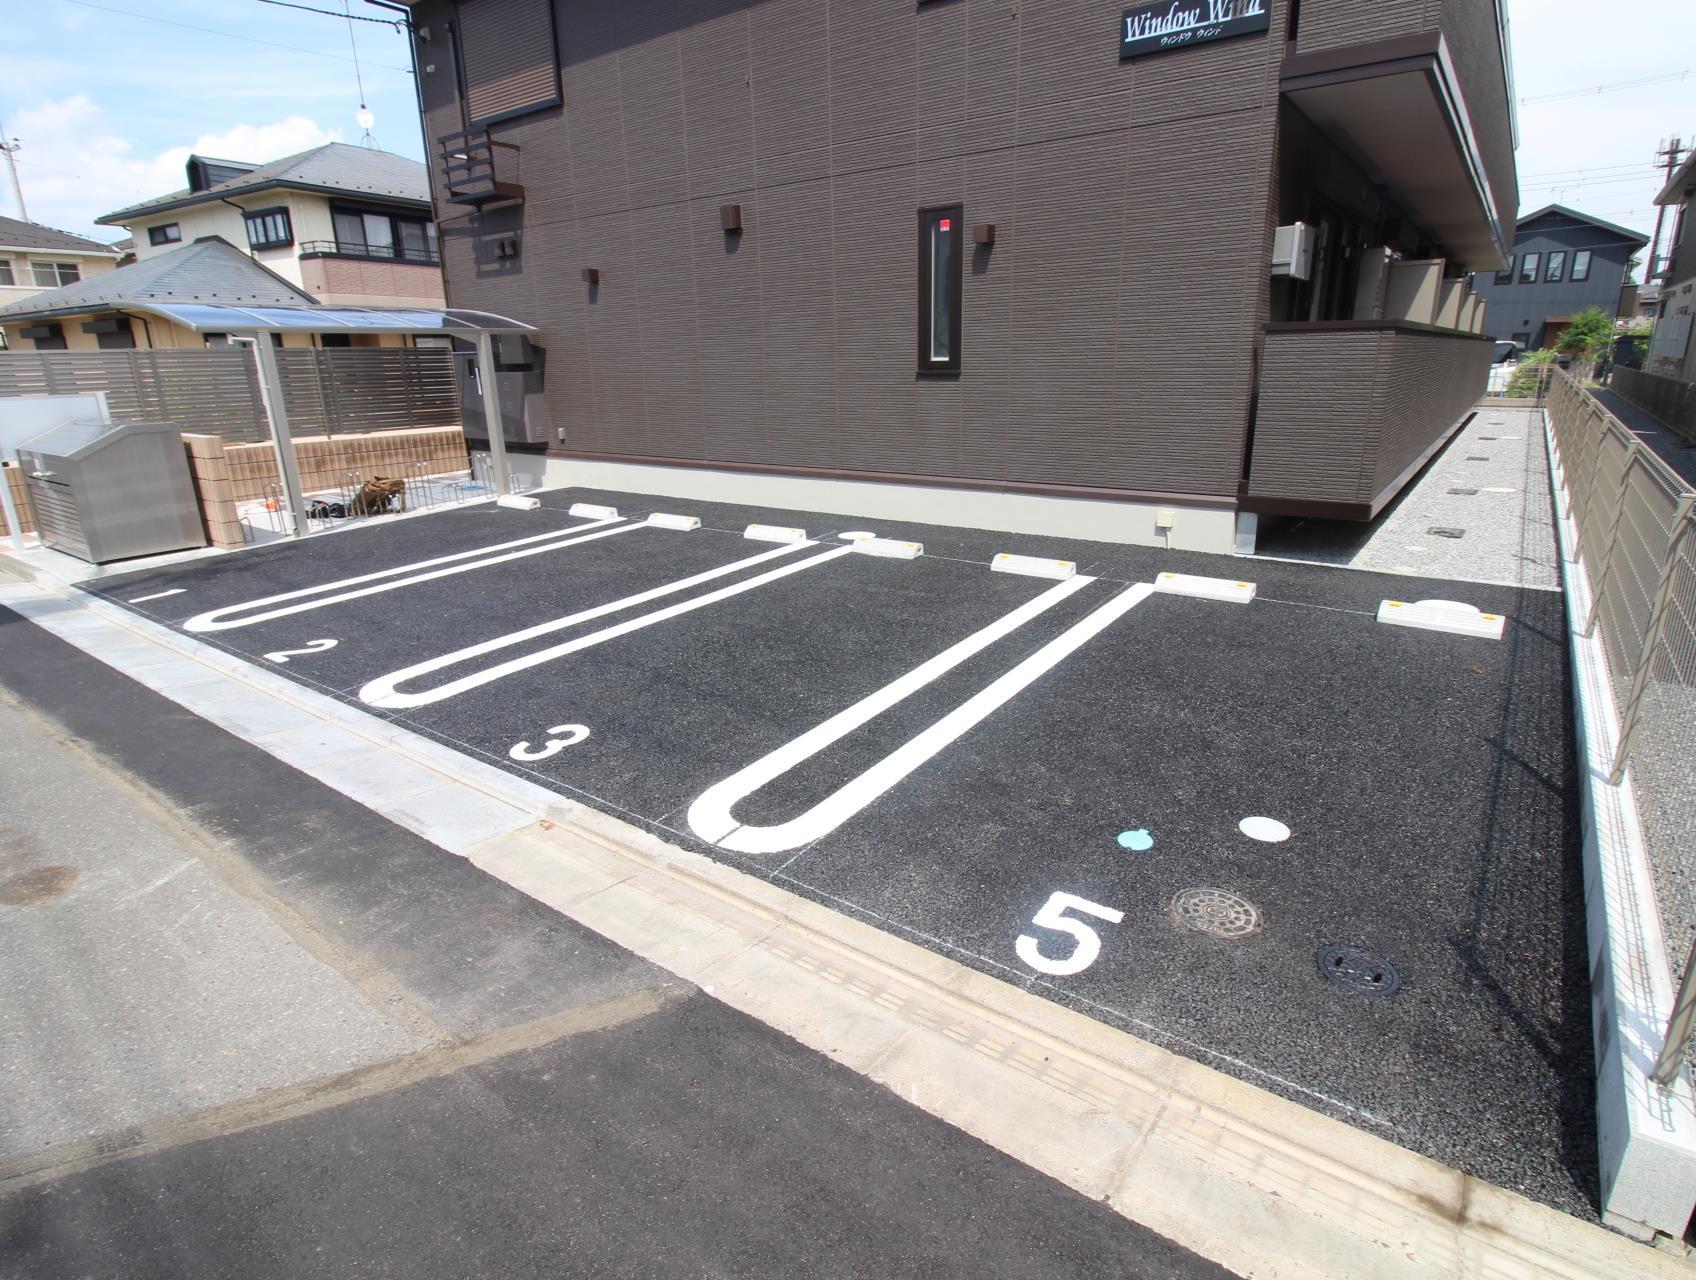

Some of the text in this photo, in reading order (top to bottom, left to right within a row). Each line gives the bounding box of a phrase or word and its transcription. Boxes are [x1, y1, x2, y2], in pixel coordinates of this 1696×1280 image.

[1126, 2, 1200, 40] Window
[1160, 25, 1224, 46] ウィンドウ ウィンド
[128, 588, 187, 603] 1
[263, 638, 339, 663] 2
[508, 723, 591, 761] 3
[1015, 890, 1125, 976] 5
